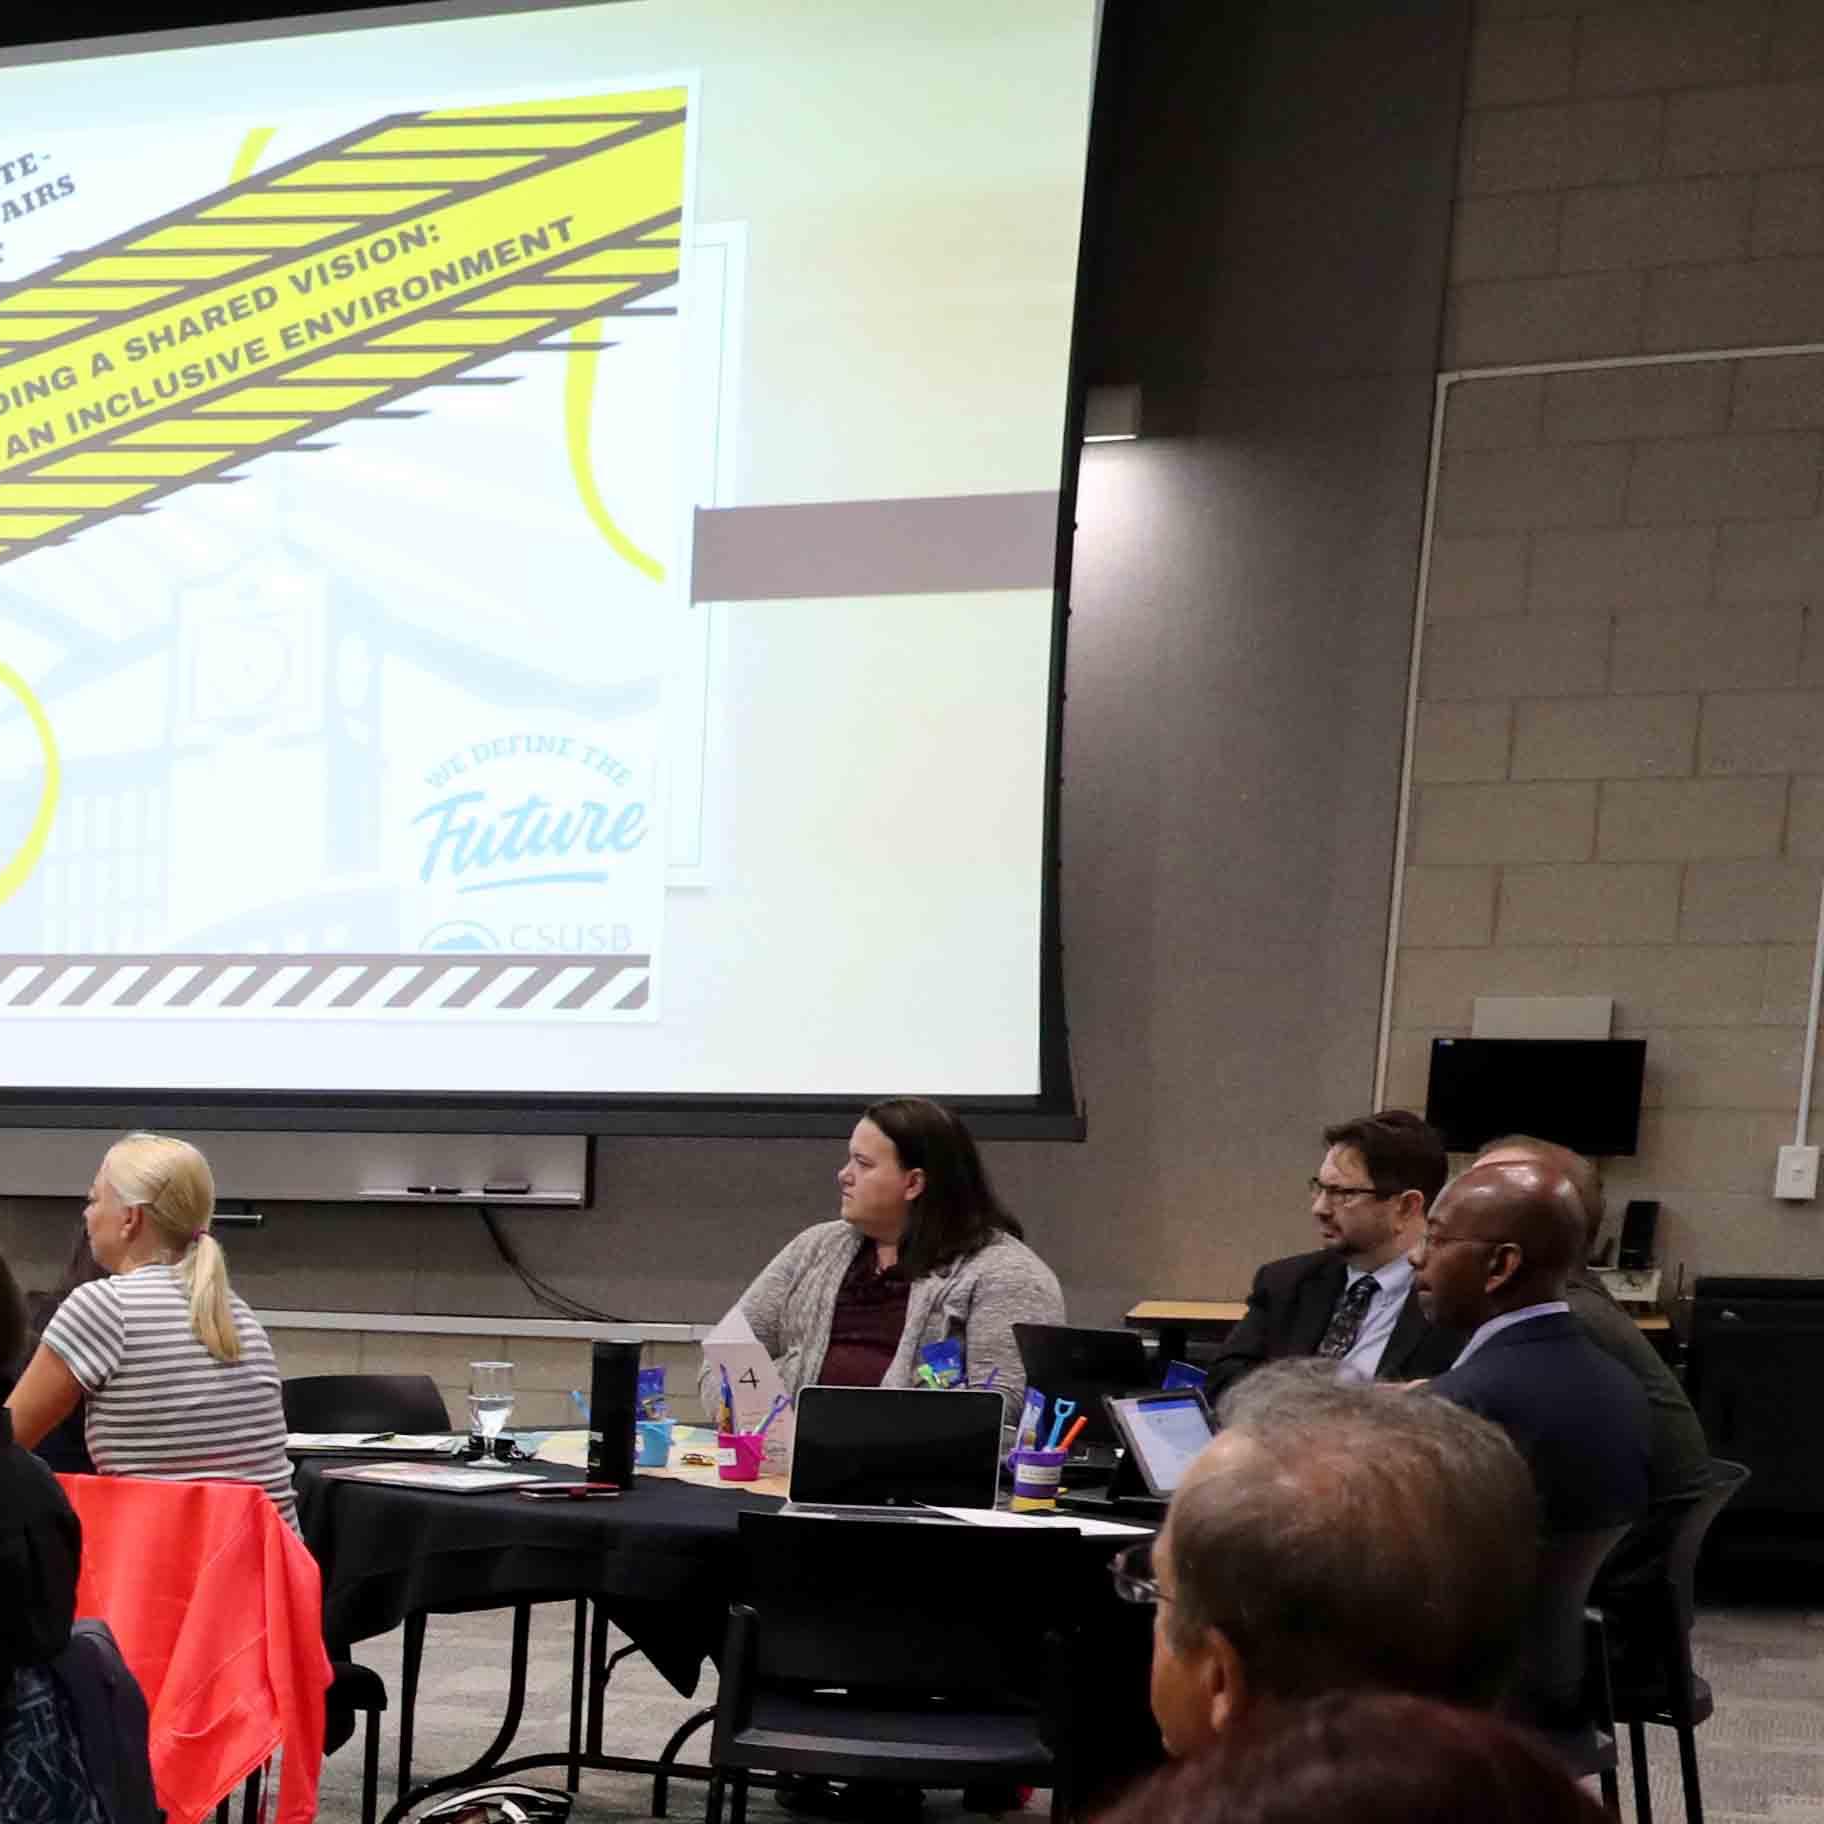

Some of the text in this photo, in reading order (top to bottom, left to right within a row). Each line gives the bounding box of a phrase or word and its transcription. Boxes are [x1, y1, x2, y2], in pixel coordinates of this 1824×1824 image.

[90, 352, 114, 376] A
[125, 284, 280, 366] SHARED
[290, 224, 442, 295] VISION:
[5, 420, 56, 460] AN
[66, 338, 271, 434] INCLUSIVE
[280, 216, 577, 350] ENVIRONMENT
[424, 735, 632, 787] WE DEFINE THE
[409, 789, 648, 883] Future
[510, 922, 633, 952] CSUSB
[739, 1368, 760, 1390] 4
